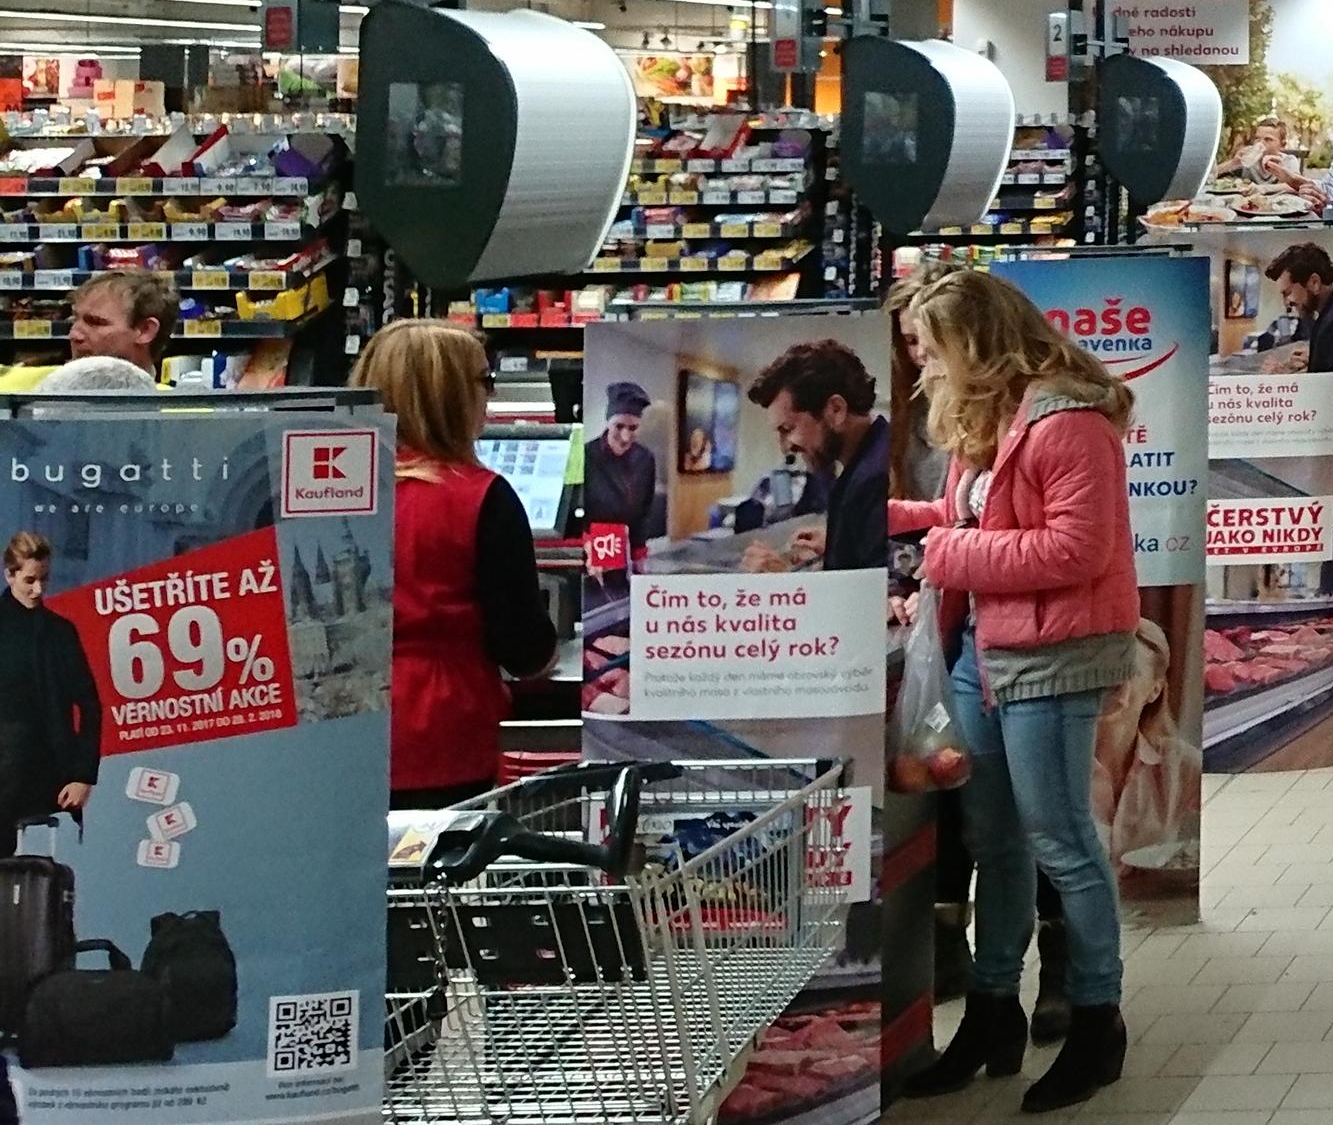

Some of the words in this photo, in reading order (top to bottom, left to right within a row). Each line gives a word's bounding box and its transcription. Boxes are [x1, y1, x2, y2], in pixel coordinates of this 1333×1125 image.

[1144, 5, 1196, 18] radosti
[1053, 24, 1062, 42] 2
[1160, 25, 1214, 40] nákupu
[1142, 46, 1160, 56] na
[1164, 44, 1239, 56] shledanou
[1078, 337, 1152, 353] avenka
[1258, 382, 1273, 394] že
[1277, 382, 1299, 394] má
[1218, 398, 1242, 410] nás
[1246, 397, 1293, 409] kvalita
[1257, 411, 1284, 426] celý
[1288, 410, 1317, 423] rok?
[11, 457, 229, 488] bugatti
[294, 485, 364, 500] Kaufland
[119, 503, 200, 515] europe
[1206, 501, 1324, 528] ČERSTVÝ
[1206, 529, 1256, 545] JAKO
[1262, 527, 1324, 544] NIKDY
[94, 569, 231, 616] UŠETŘÍTE
[238, 560, 278, 596] AŽ
[645, 584, 689, 609] Čím
[697, 589, 728, 611] to,
[735, 588, 761, 607] že
[769, 587, 807, 607] má
[645, 619, 659, 634] u
[666, 615, 707, 634] nás
[714, 613, 797, 634] kvalita
[108, 605, 275, 699] 69%
[645, 641, 726, 660] sezónu
[734, 638, 780, 663] celý
[788, 635, 840, 658] rok?
[111, 686, 225, 726] VĚRNOSTNÍ
[229, 683, 282, 710] AKCE
